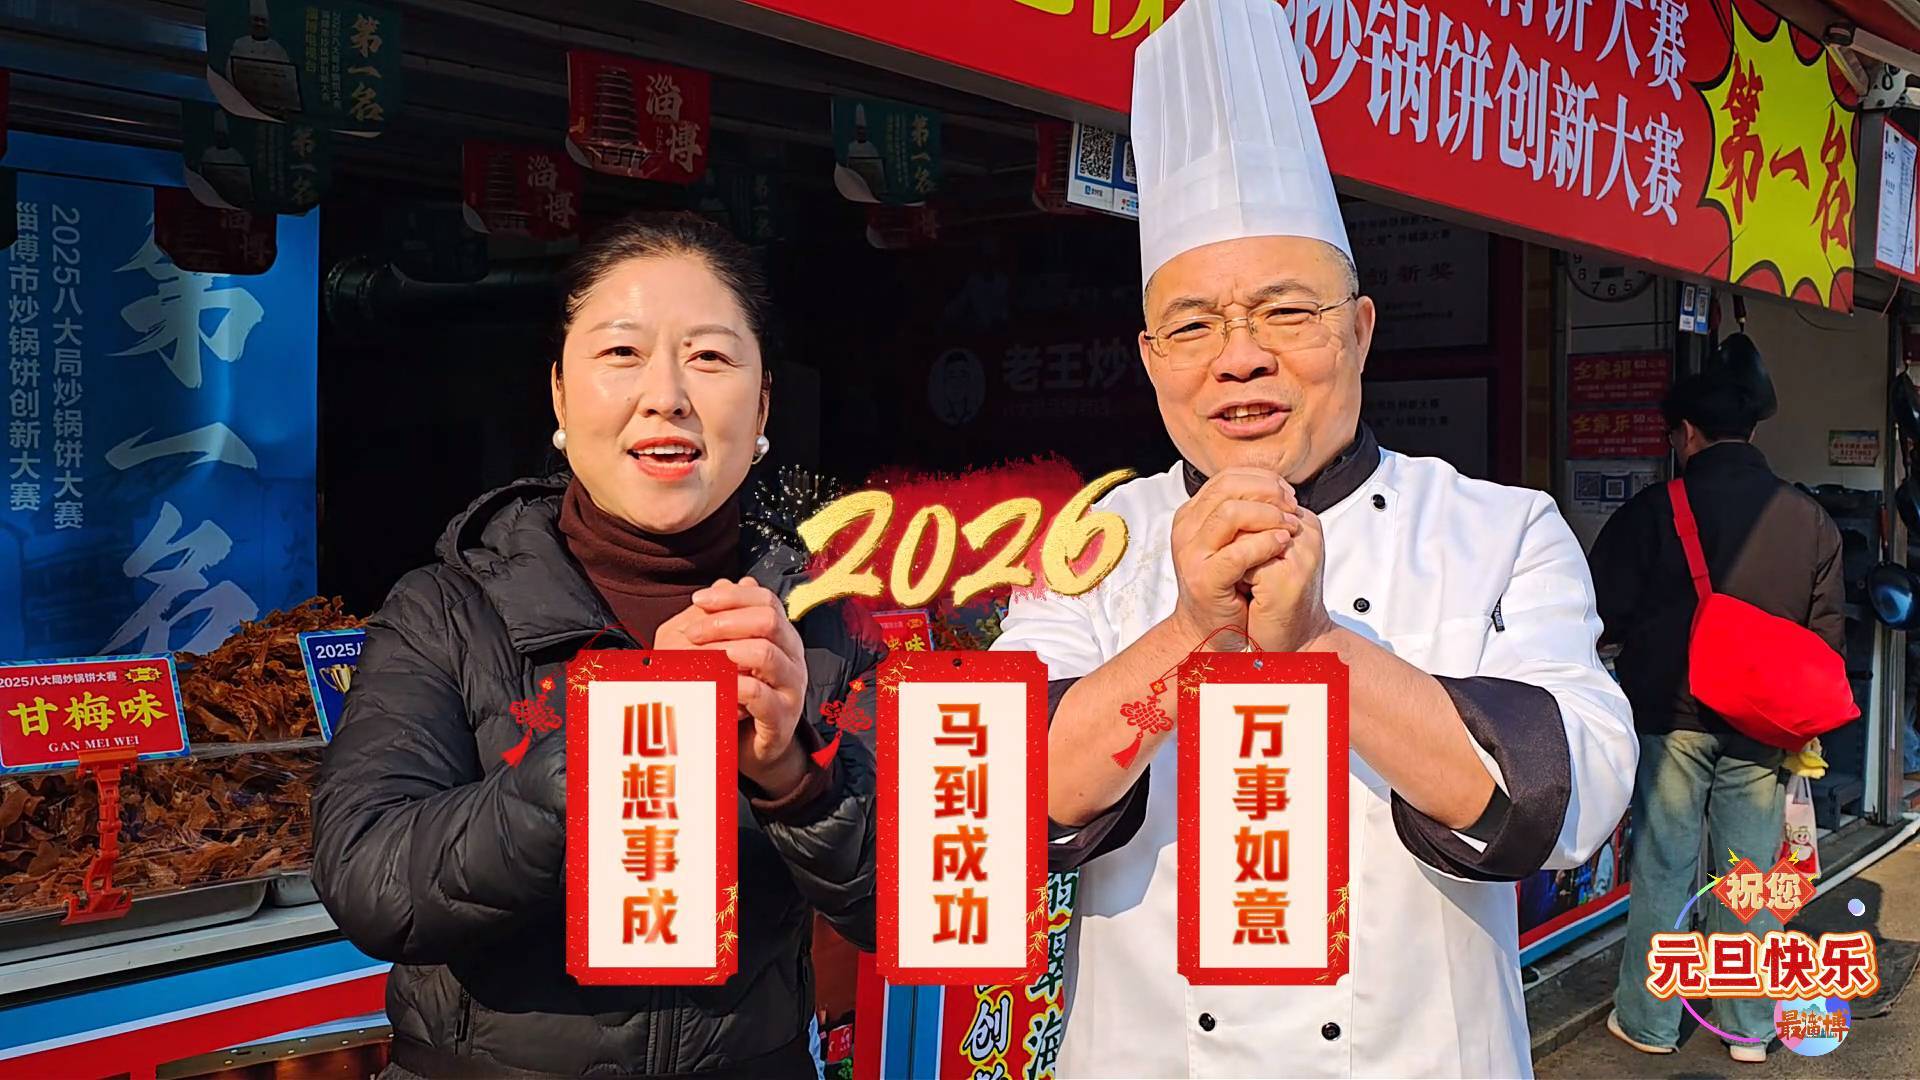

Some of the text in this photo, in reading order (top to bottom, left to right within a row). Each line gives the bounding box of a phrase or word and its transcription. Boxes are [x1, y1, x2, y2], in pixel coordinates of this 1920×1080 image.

[347, 12, 384, 123] 第一名
[1488, 0, 1689, 100] 大赛
[644, 73, 703, 173] 淄博
[1715, 52, 1849, 253] 第一名
[527, 155, 577, 229] 淄博
[51, 204, 84, 530] 2025八大局炒锅饼大赛
[0, 671, 118, 688] 2025八大局炒锅饼大赛
[8, 688, 169, 736] 甘梅味
[48, 735, 140, 753] GAN MEI WEI
